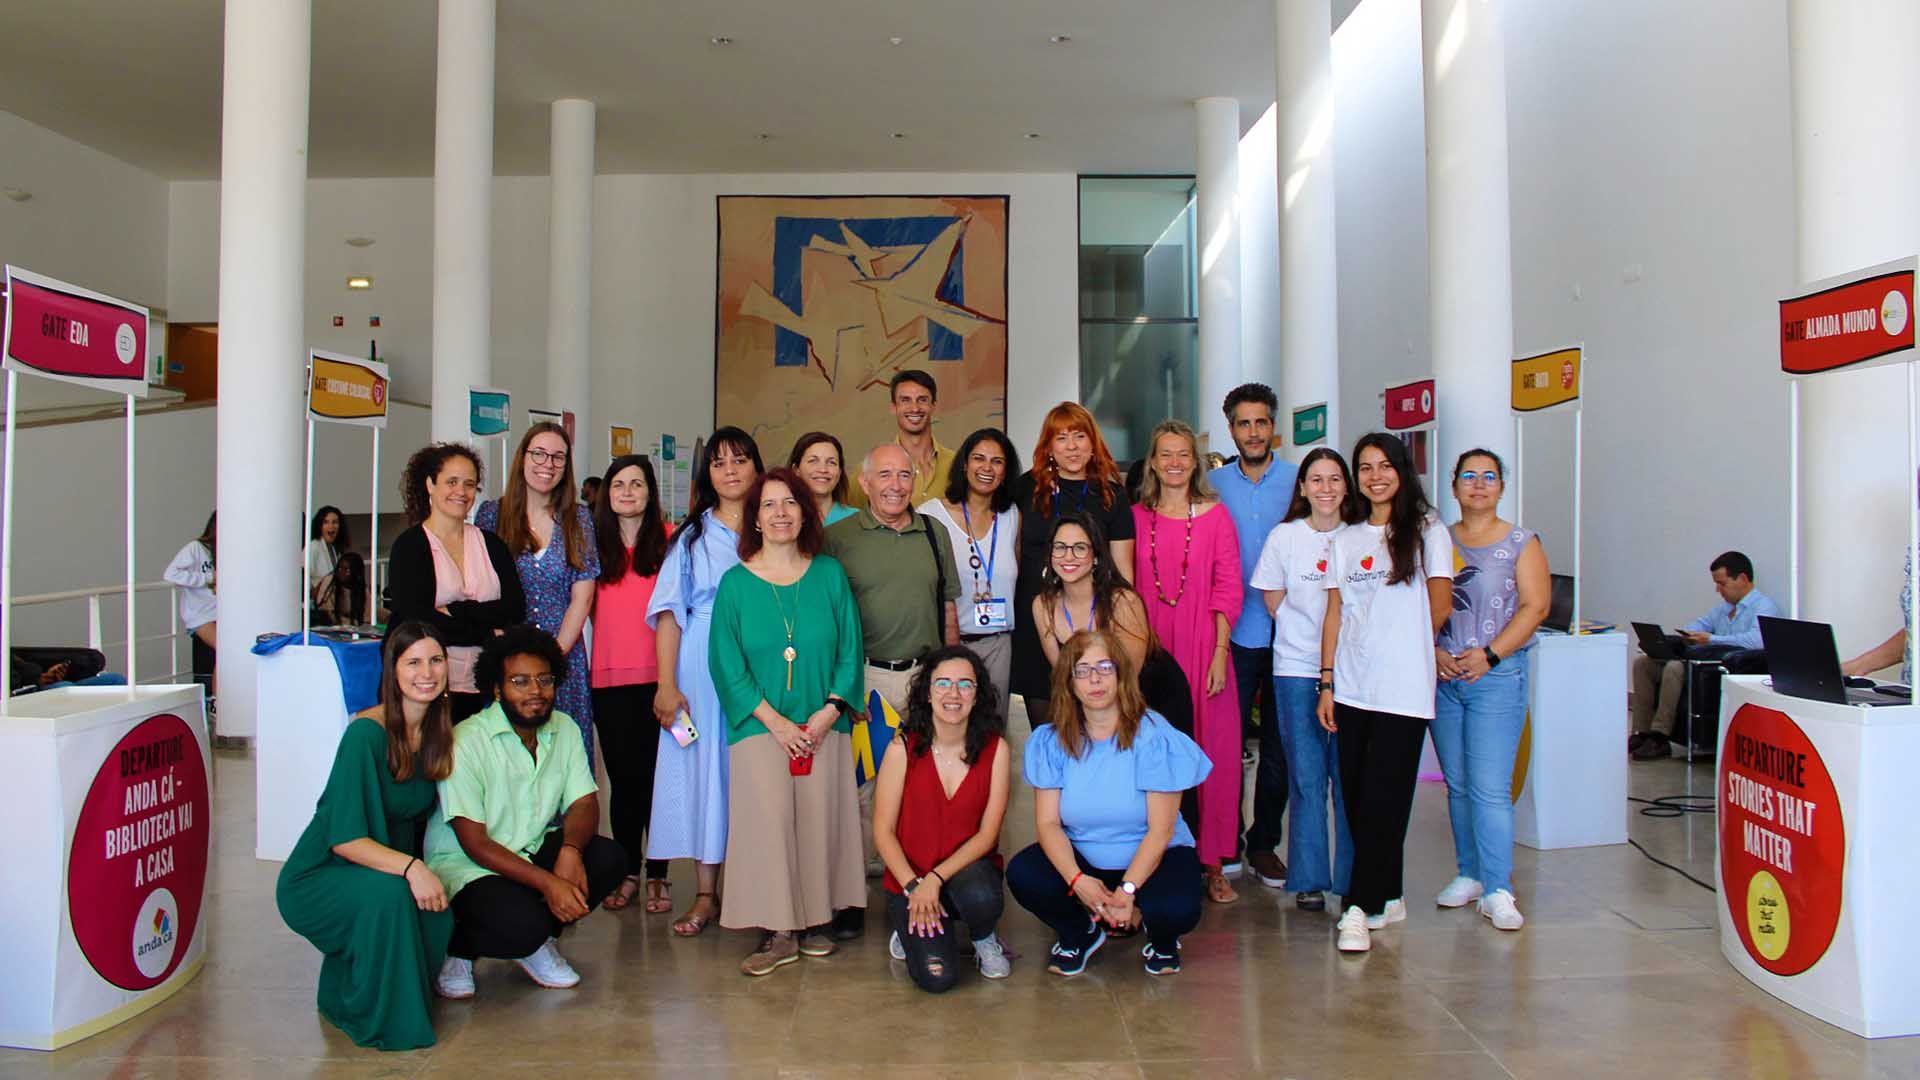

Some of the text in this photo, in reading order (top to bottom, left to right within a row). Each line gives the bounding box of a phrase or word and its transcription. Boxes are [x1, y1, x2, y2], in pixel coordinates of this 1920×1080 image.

[42, 313, 88, 347] GATE EDA
[1785, 308, 1876, 341] GATE ALMADA MUNDO
[121, 735, 184, 777] DEPARTURE
[1735, 734, 1806, 788] DEPARTURE
[124, 779, 158, 816] ANDA
[161, 766, 174, 803] CÁ
[1728, 771, 1816, 837] STORIES THAT
[105, 800, 193, 860] BIBLIOTECA VAI
[1743, 820, 1793, 873] MATTER
[135, 845, 175, 887] A CASA
[138, 936, 163, 956] anda
